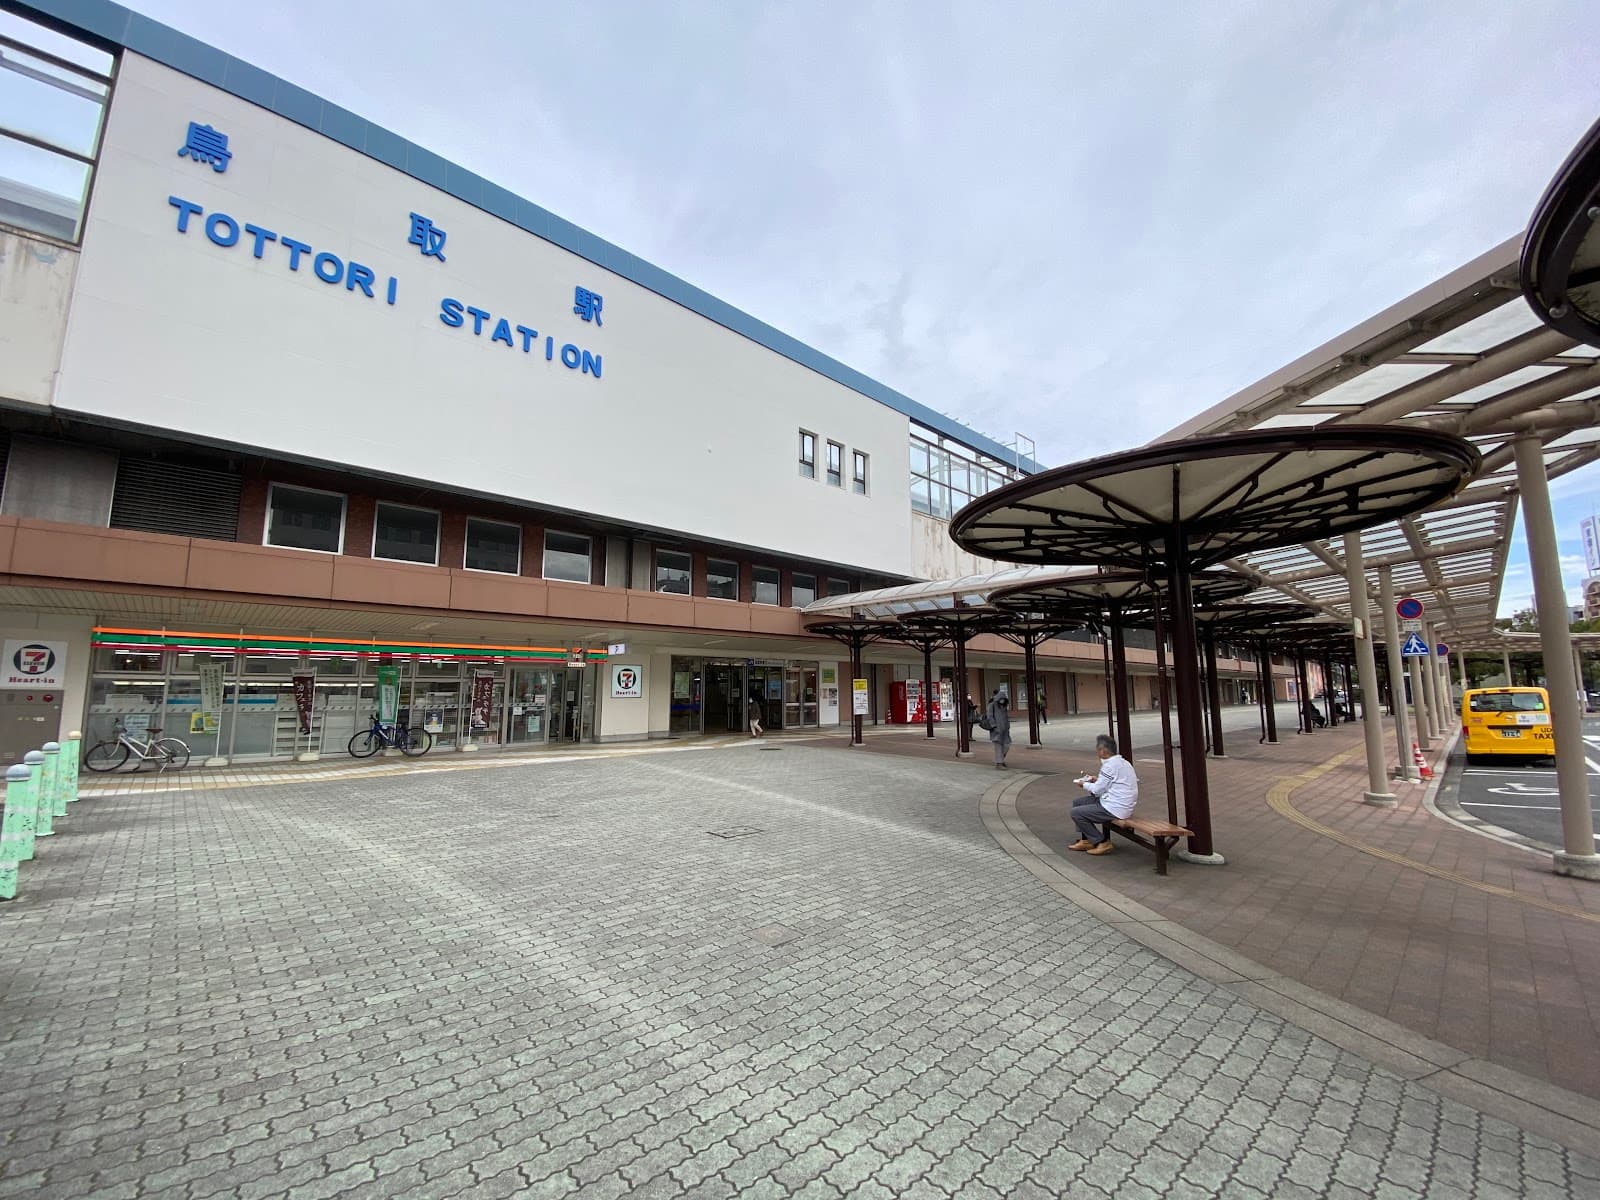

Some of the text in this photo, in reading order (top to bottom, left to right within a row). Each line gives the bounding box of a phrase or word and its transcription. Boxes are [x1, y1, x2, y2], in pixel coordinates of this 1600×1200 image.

[169, 195, 602, 378] TOTTORI STATION
[25, 651, 46, 672] 7
